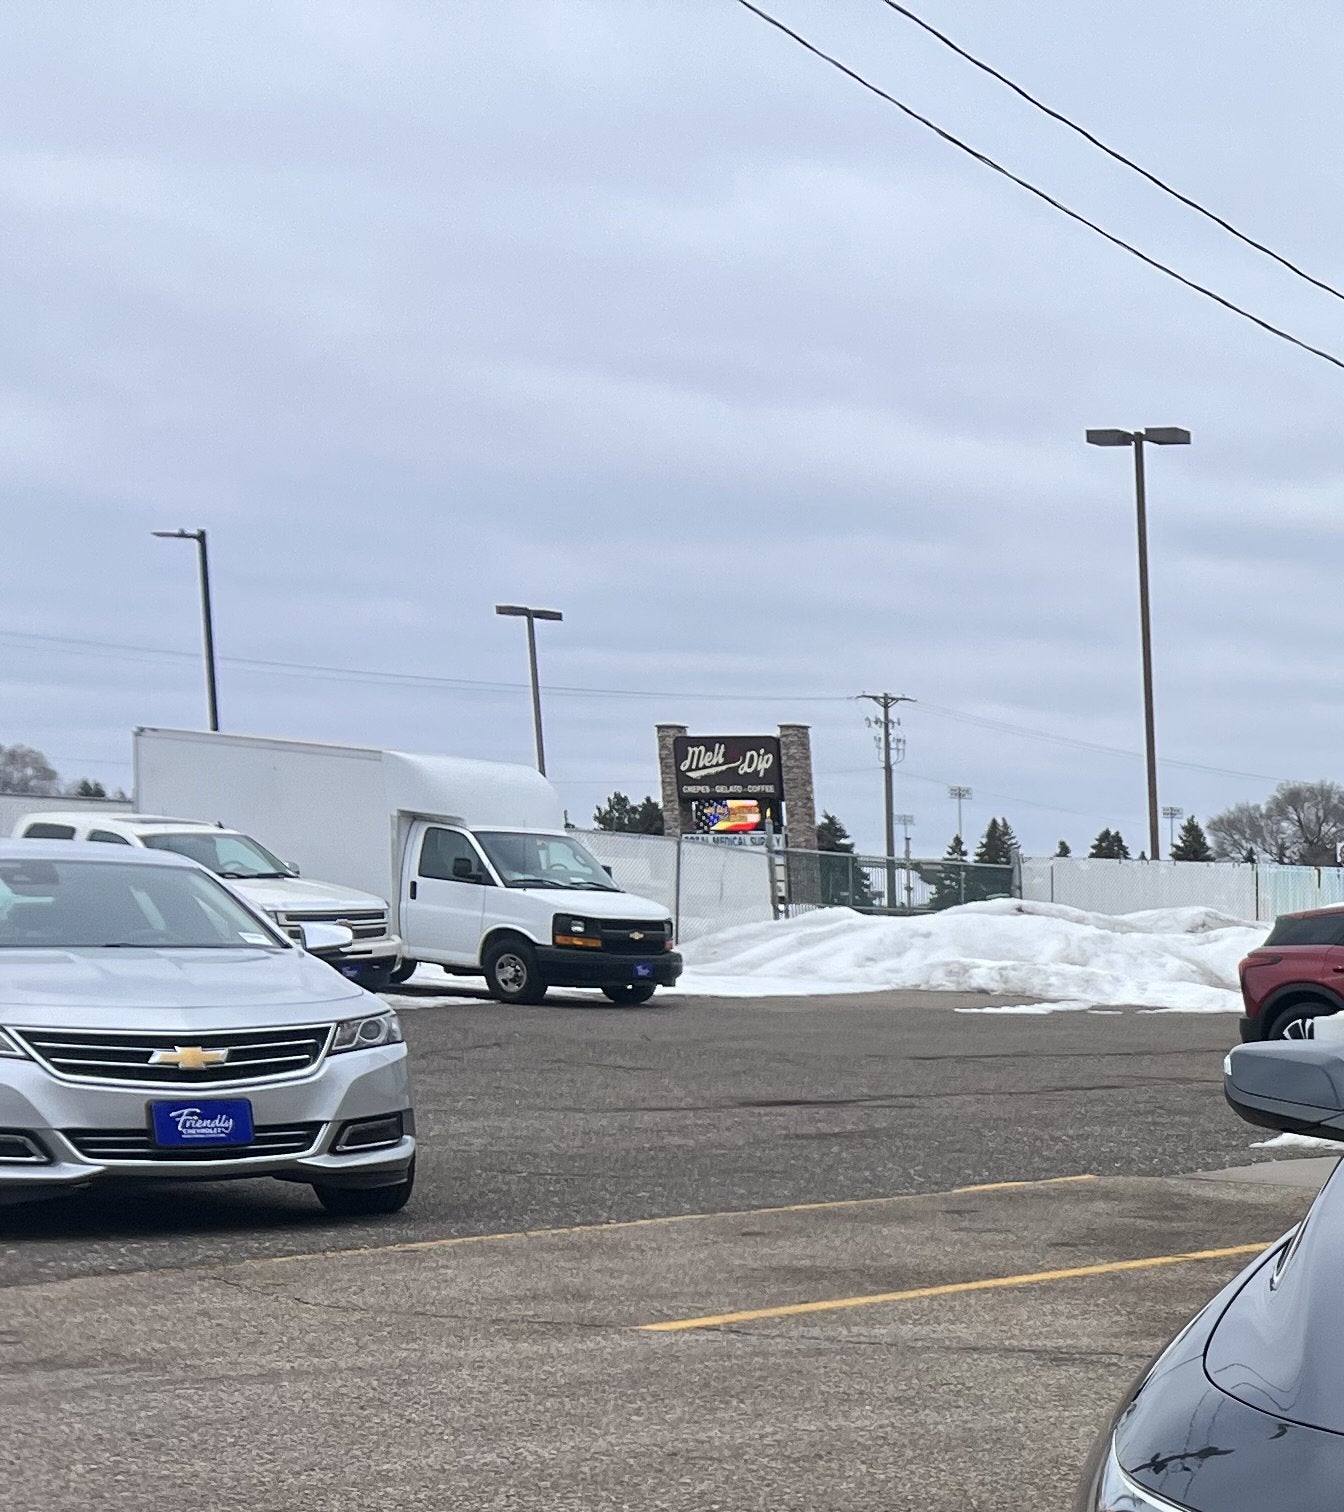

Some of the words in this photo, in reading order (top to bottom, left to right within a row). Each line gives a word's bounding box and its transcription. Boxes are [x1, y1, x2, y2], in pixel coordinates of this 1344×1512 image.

[680, 743, 726, 771] Melt
[738, 749, 774, 777] Dip
[682, 785, 711, 794] CREPES
[715, 785, 743, 794] GELATO
[747, 785, 775, 794] COFFEE
[750, 836, 781, 847] SUPY
[169, 1108, 233, 1133] Friendly
